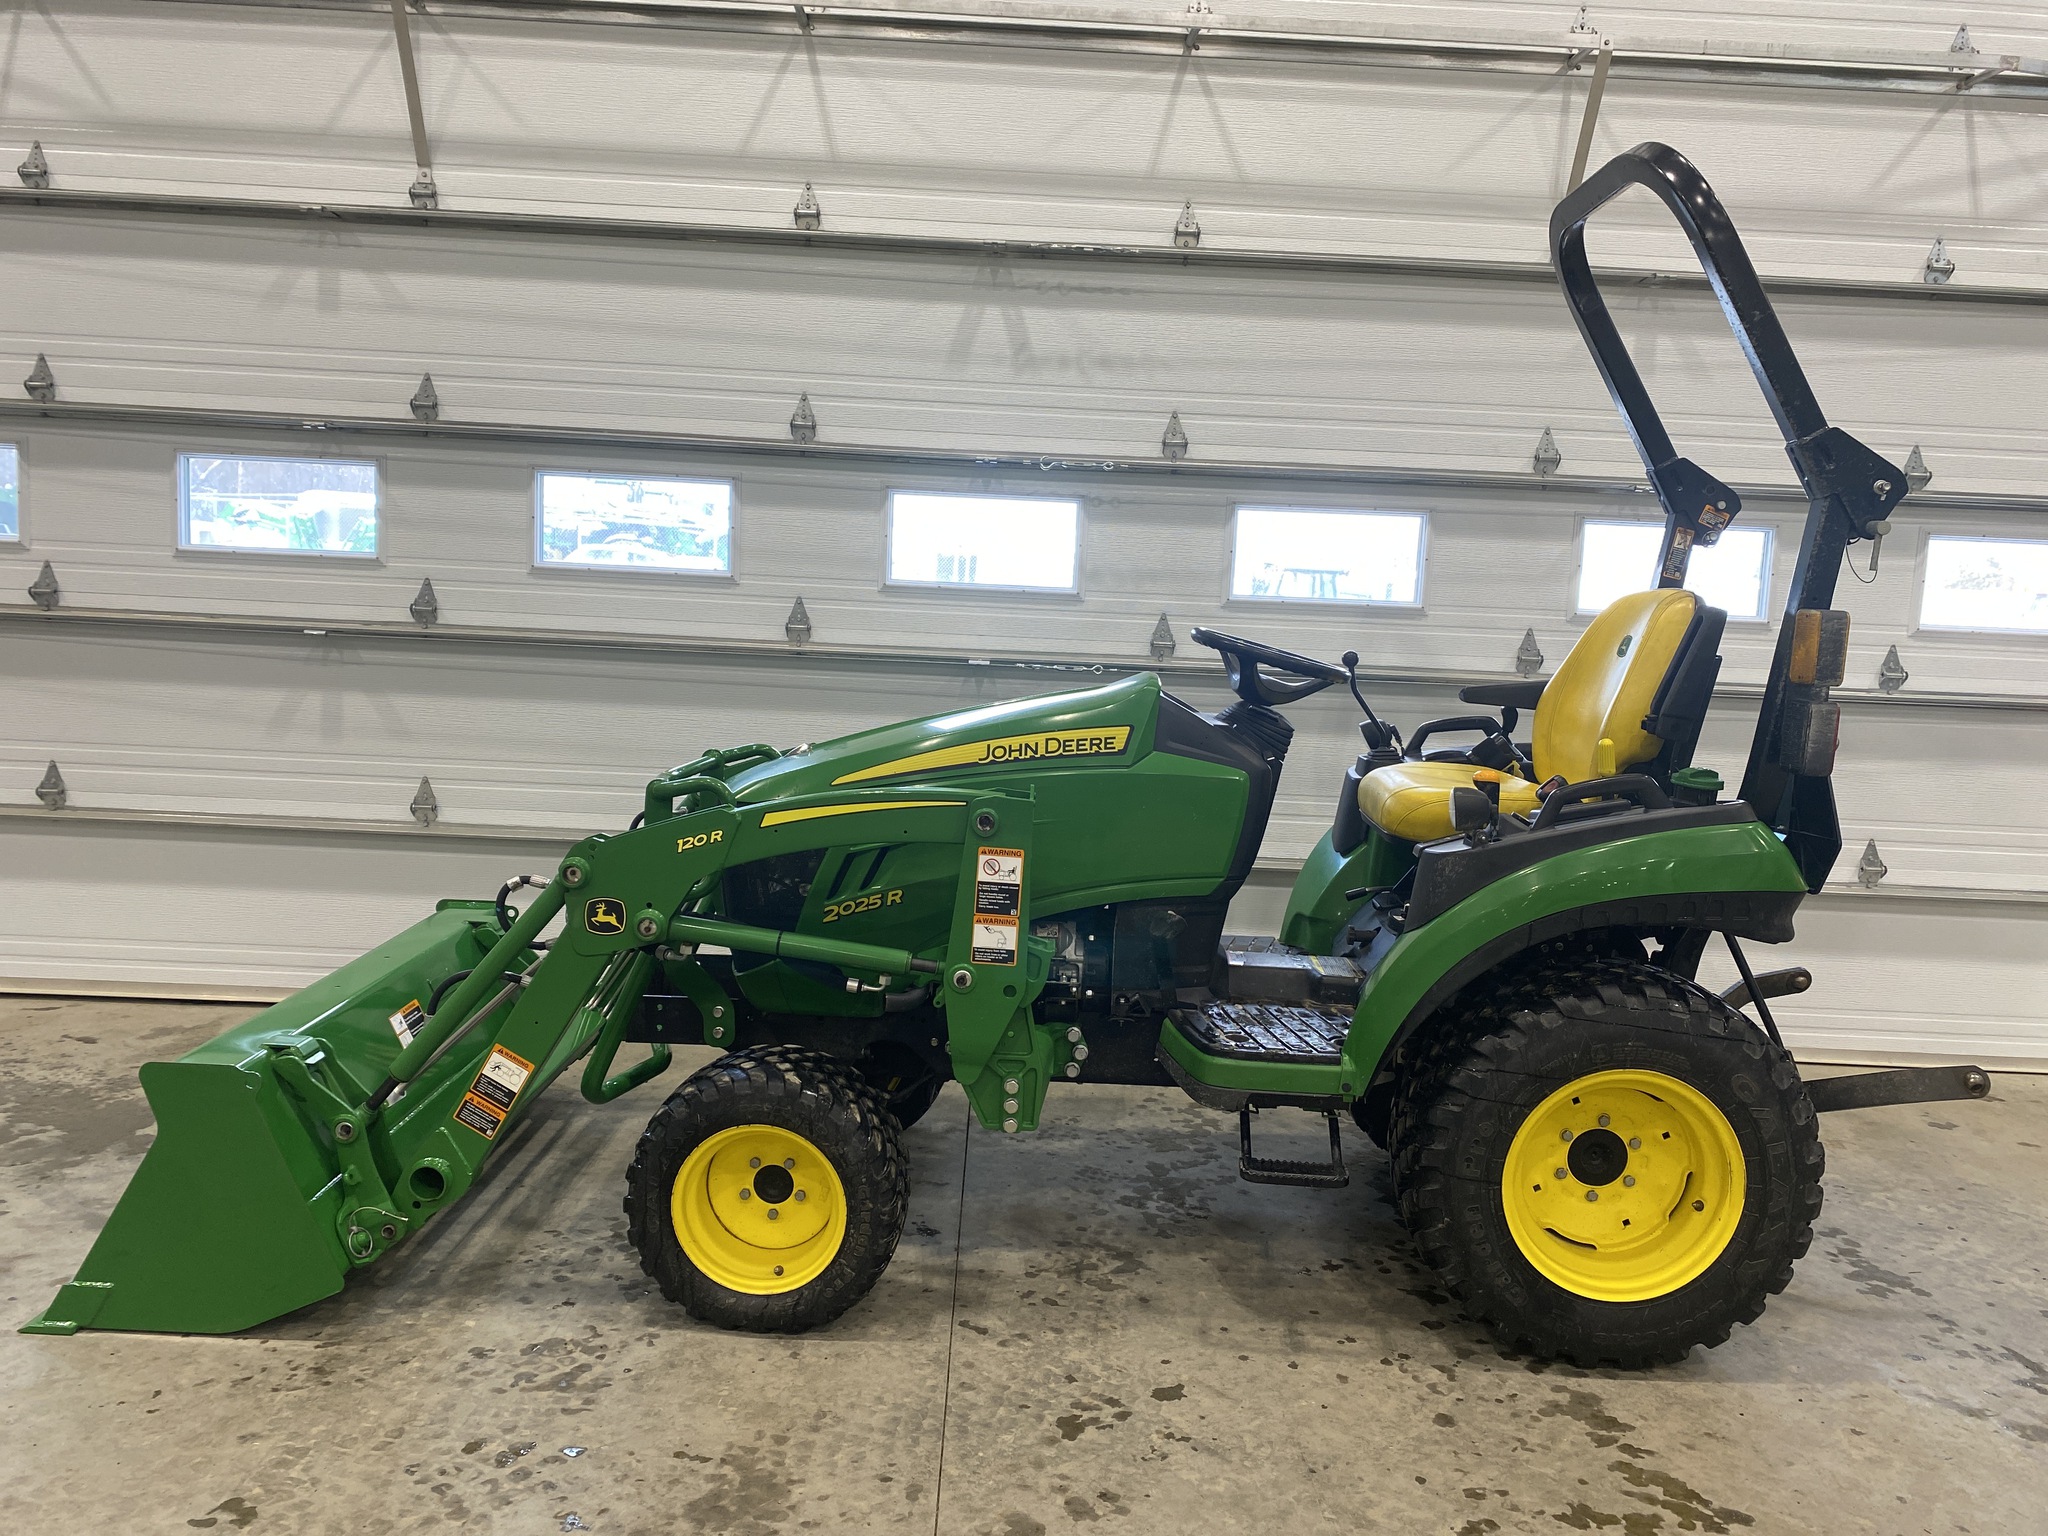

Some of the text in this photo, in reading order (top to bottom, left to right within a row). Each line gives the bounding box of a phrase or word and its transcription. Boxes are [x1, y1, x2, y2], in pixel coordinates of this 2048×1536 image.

[978, 736, 1117, 763] JOHN DEERE
[677, 830, 723, 853] 120 R
[987, 848, 1022, 857] WARNING
[822, 889, 903, 923] 2025 R
[982, 917, 1016, 926] WARNING
[504, 1050, 529, 1069] WARNING
[476, 1099, 501, 1118] WARNING
